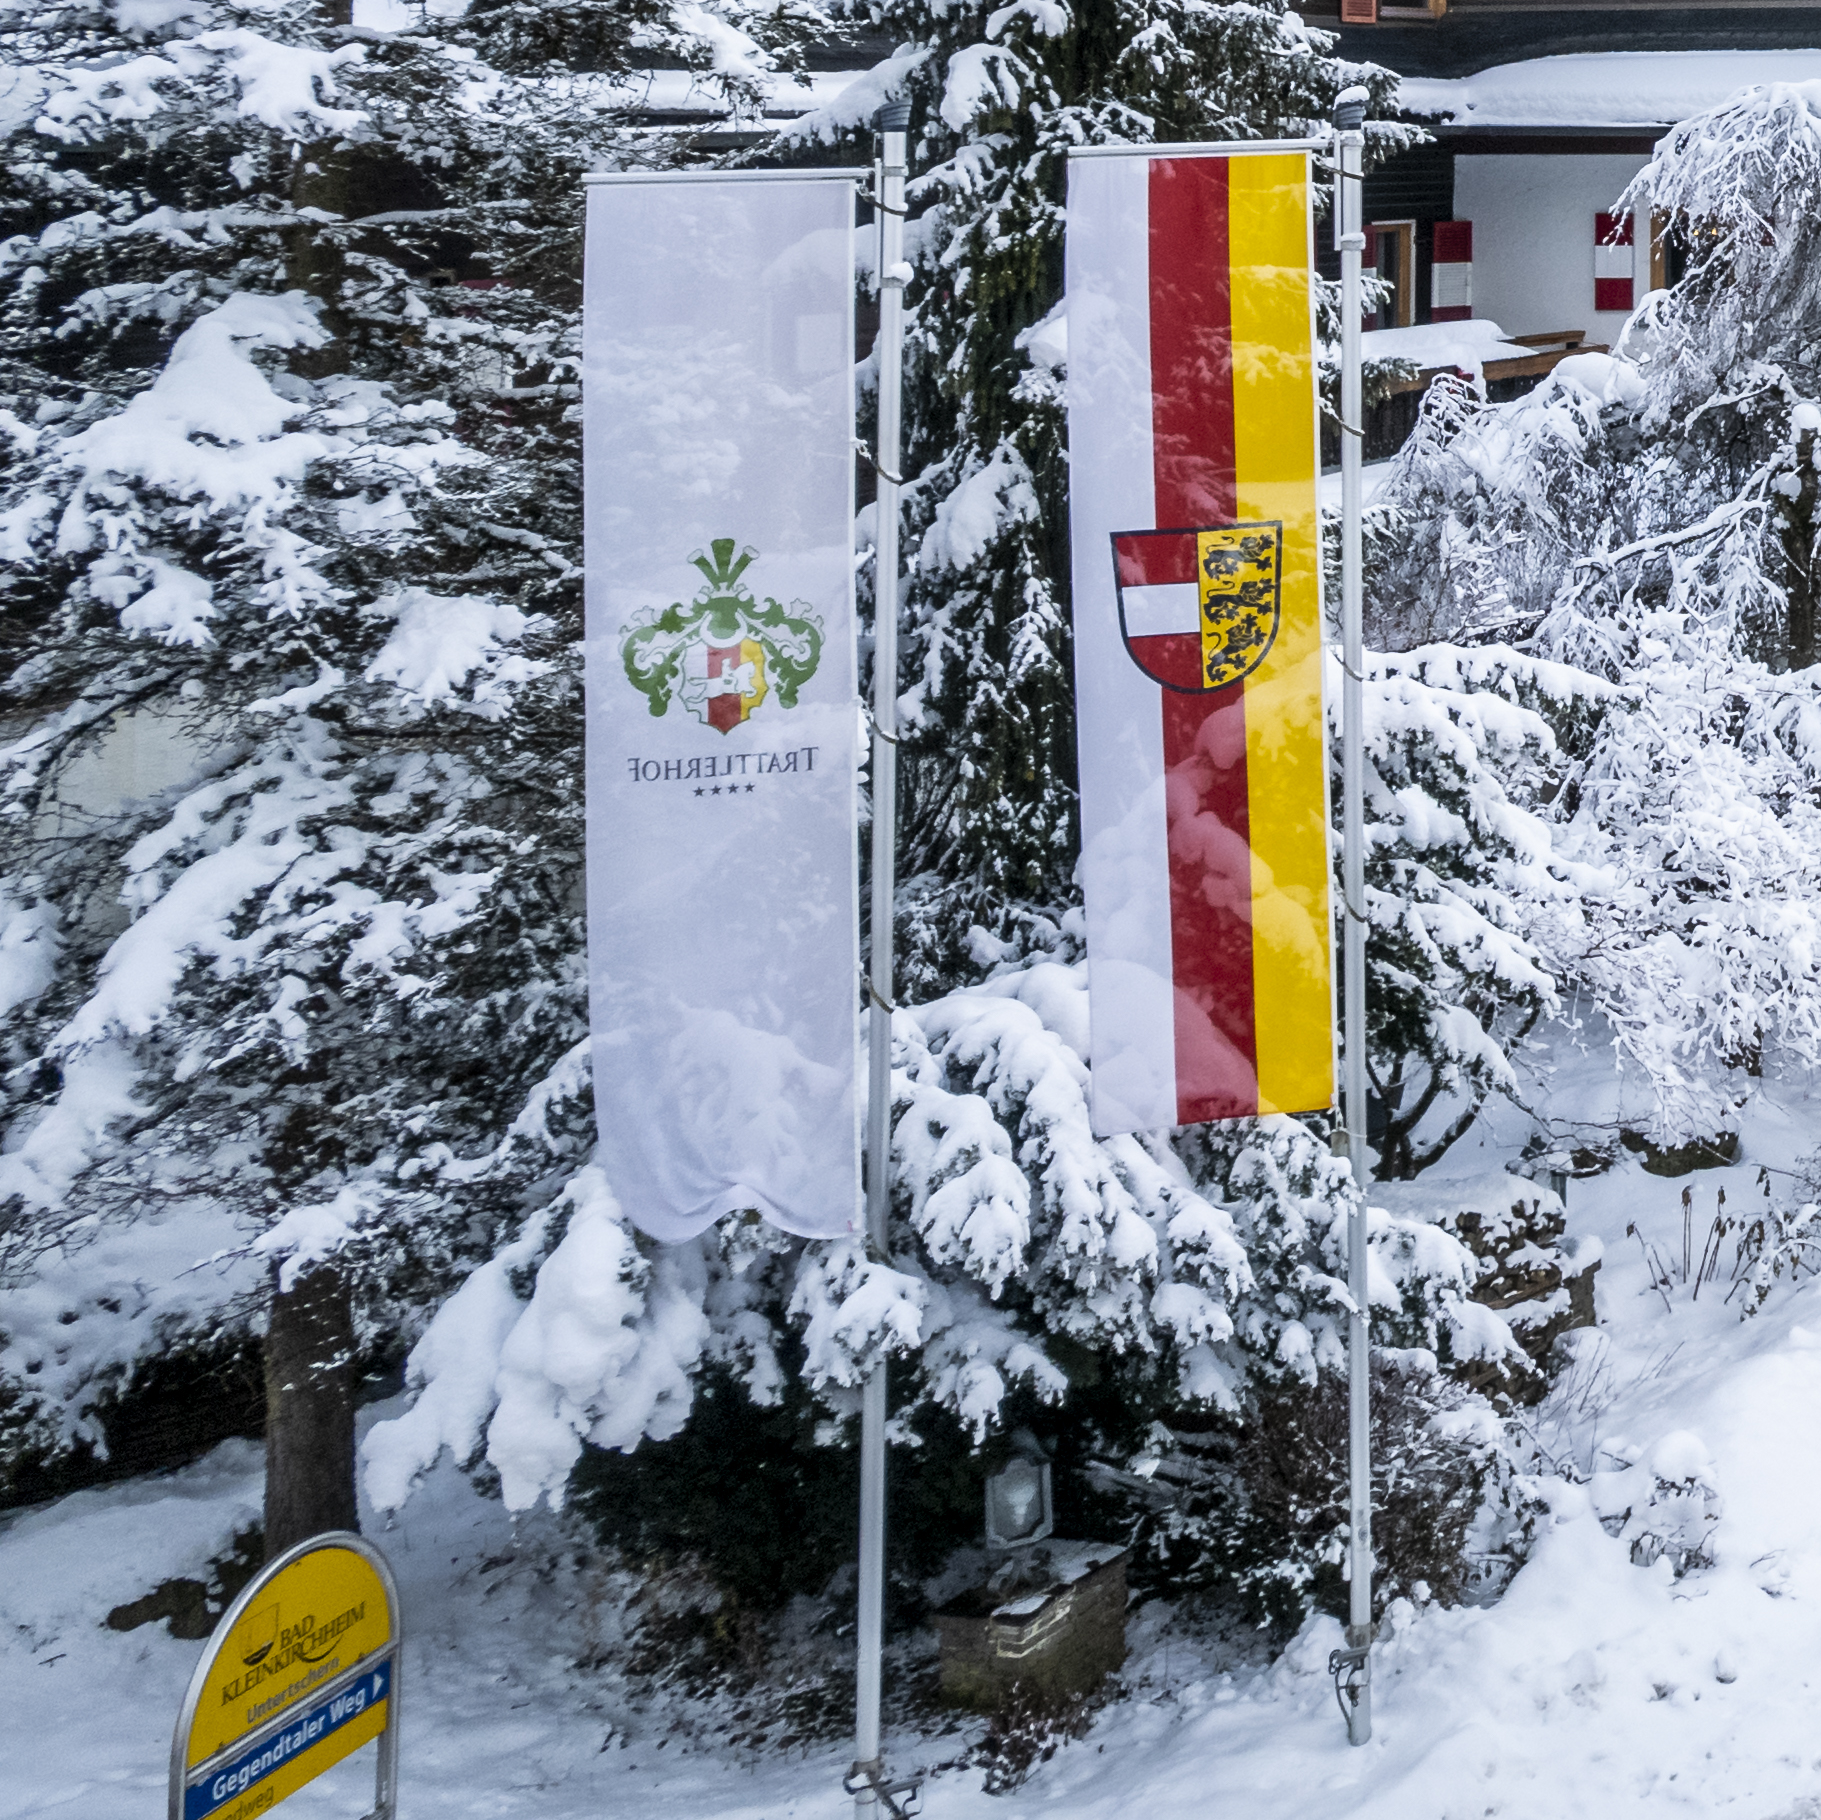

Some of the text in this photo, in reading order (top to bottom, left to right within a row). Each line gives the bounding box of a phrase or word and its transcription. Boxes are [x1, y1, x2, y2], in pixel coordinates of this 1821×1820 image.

[221, 1600, 366, 1707] KLEINKIRCHHEIM
[280, 1614, 316, 1651] BAD
[212, 1687, 366, 1801] Gegendtaler Weg
